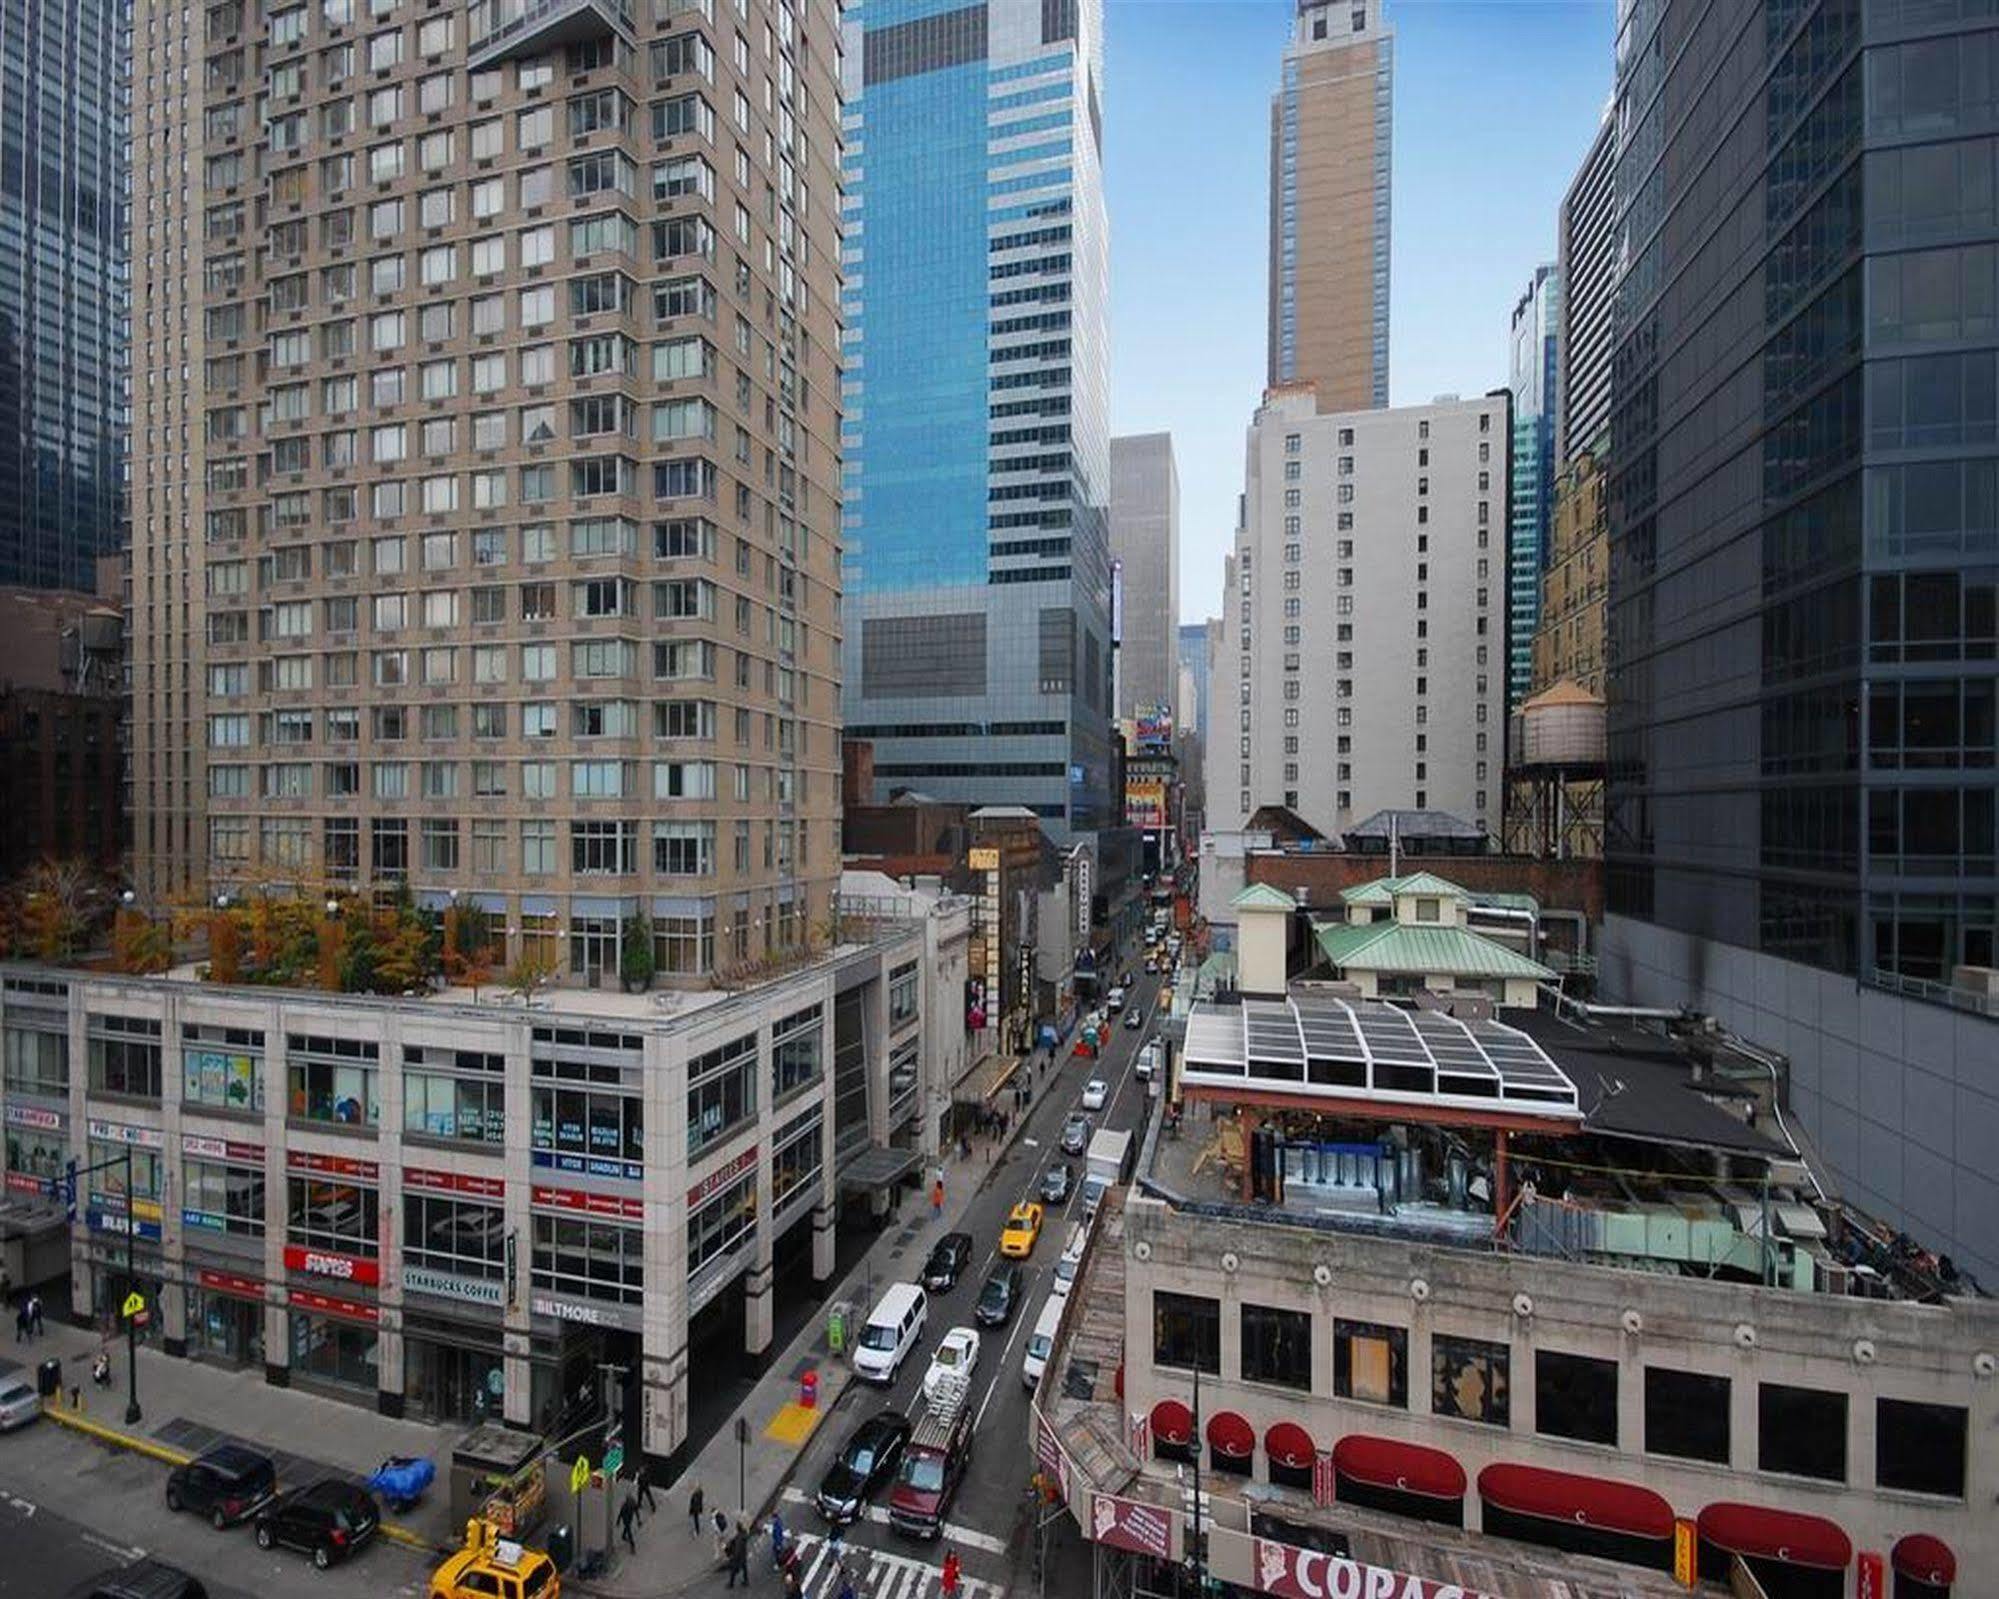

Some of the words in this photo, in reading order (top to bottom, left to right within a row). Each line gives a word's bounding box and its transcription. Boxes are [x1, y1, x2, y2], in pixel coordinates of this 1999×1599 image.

[405, 1271, 462, 1293] STARBUCKS
[464, 1283, 501, 1301] COFFEE
[535, 1299, 599, 1324] BILTMORE
